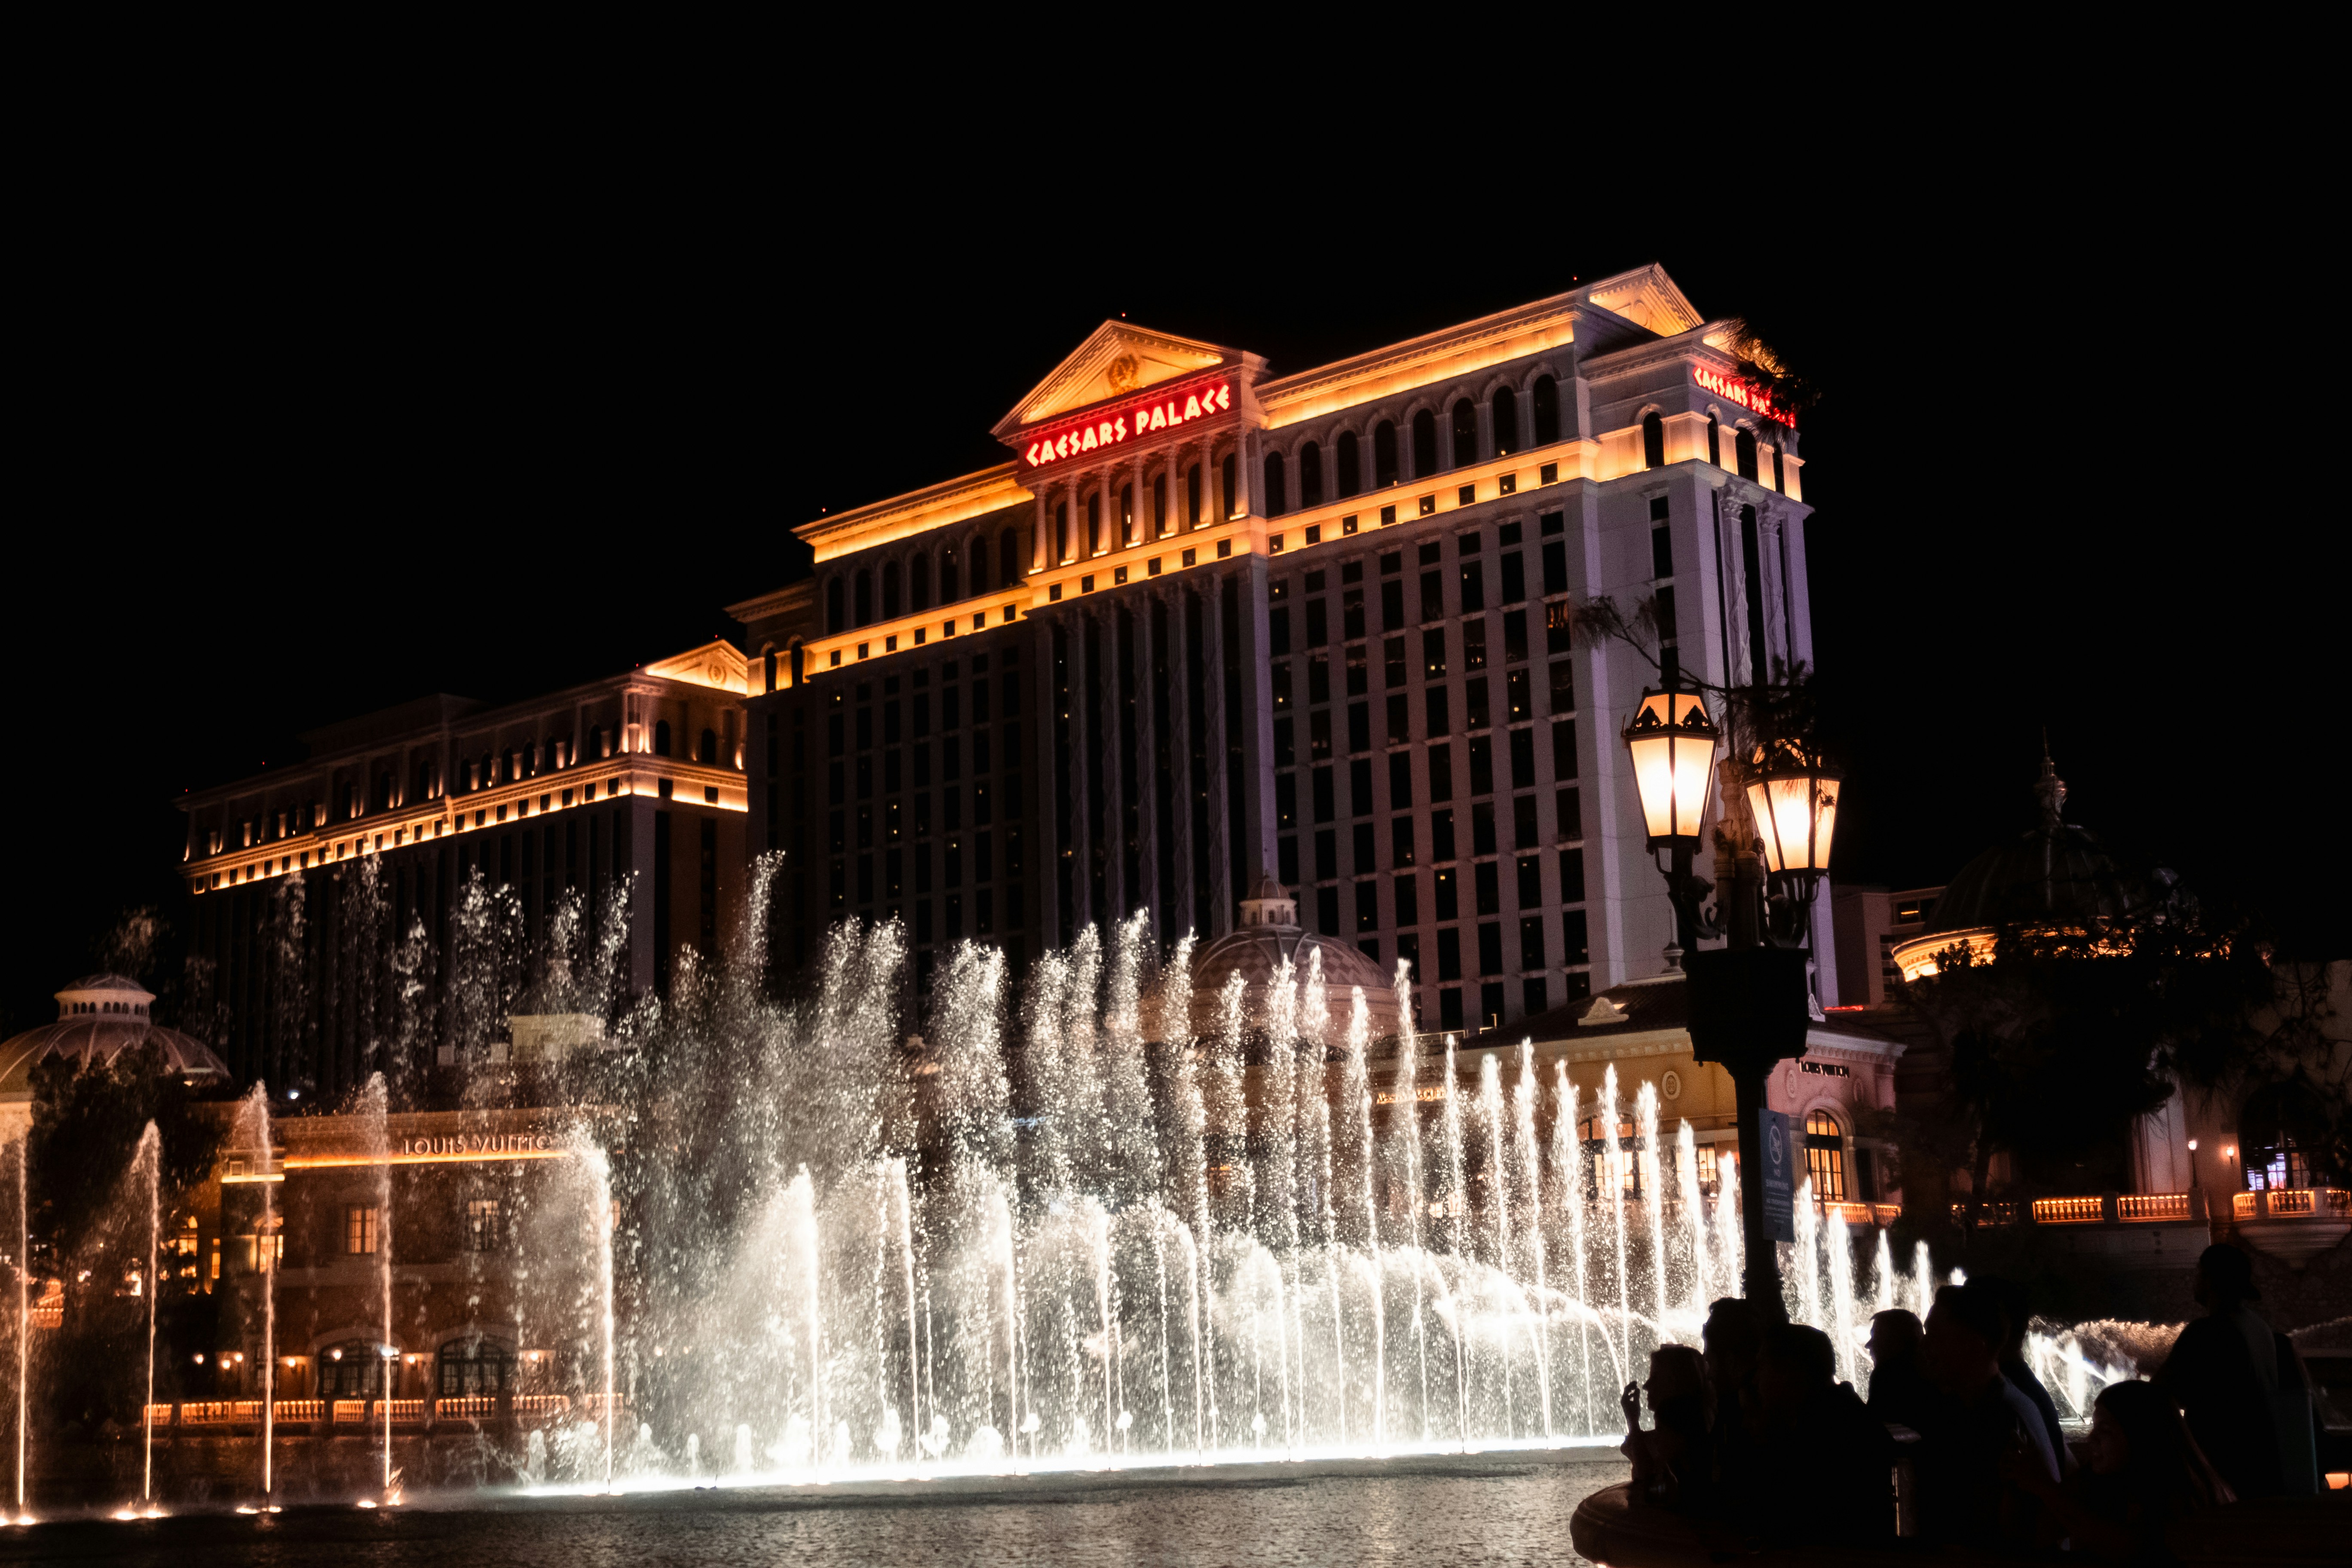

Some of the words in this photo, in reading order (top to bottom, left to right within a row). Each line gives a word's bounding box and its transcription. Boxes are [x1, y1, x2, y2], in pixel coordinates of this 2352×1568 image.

[1694, 368, 1748, 407] CAESARS
[1026, 417, 1127, 467] CAESARS
[1136, 385, 1230, 435] PALACE
[404, 1135, 467, 1156] LOUIS
